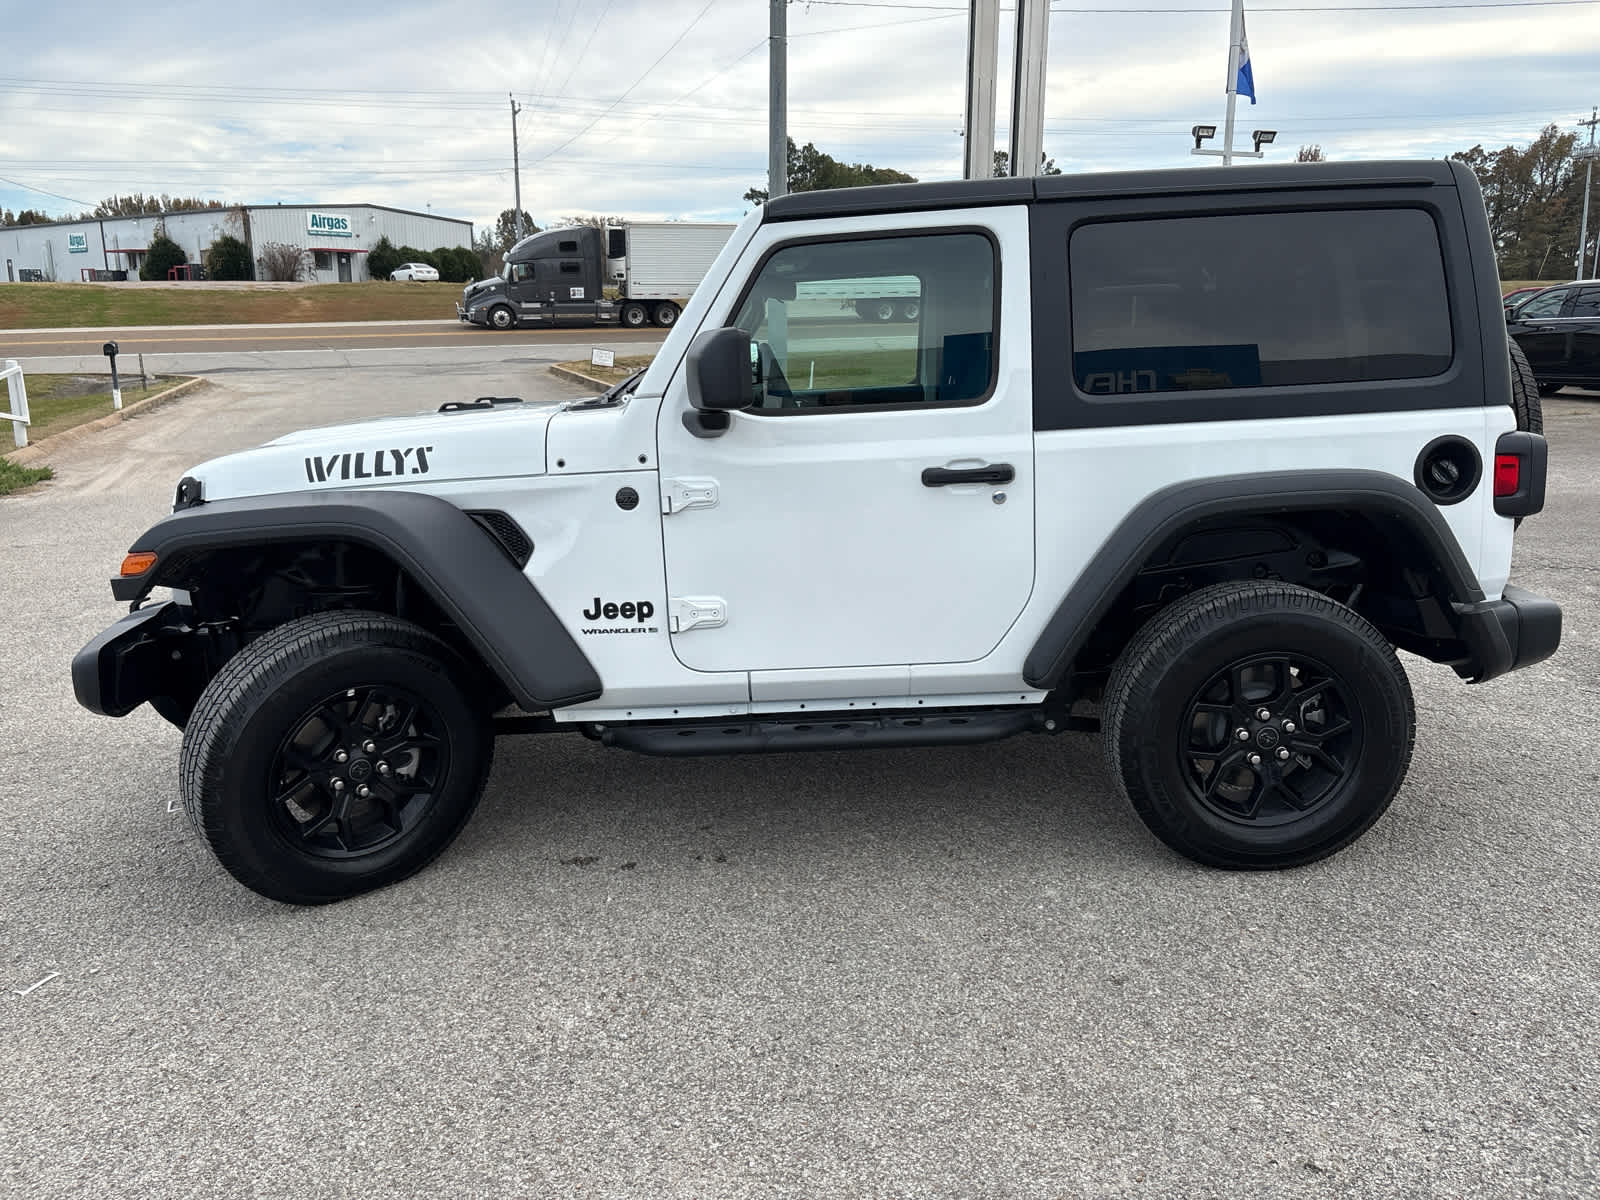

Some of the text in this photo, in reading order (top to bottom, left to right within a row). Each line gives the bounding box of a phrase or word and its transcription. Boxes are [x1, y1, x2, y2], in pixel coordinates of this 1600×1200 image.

[311, 213, 348, 230] Airgas
[305, 446, 433, 483] WILLYS
[583, 597, 654, 623] Jeep
[581, 627, 646, 635] WRANGLER
